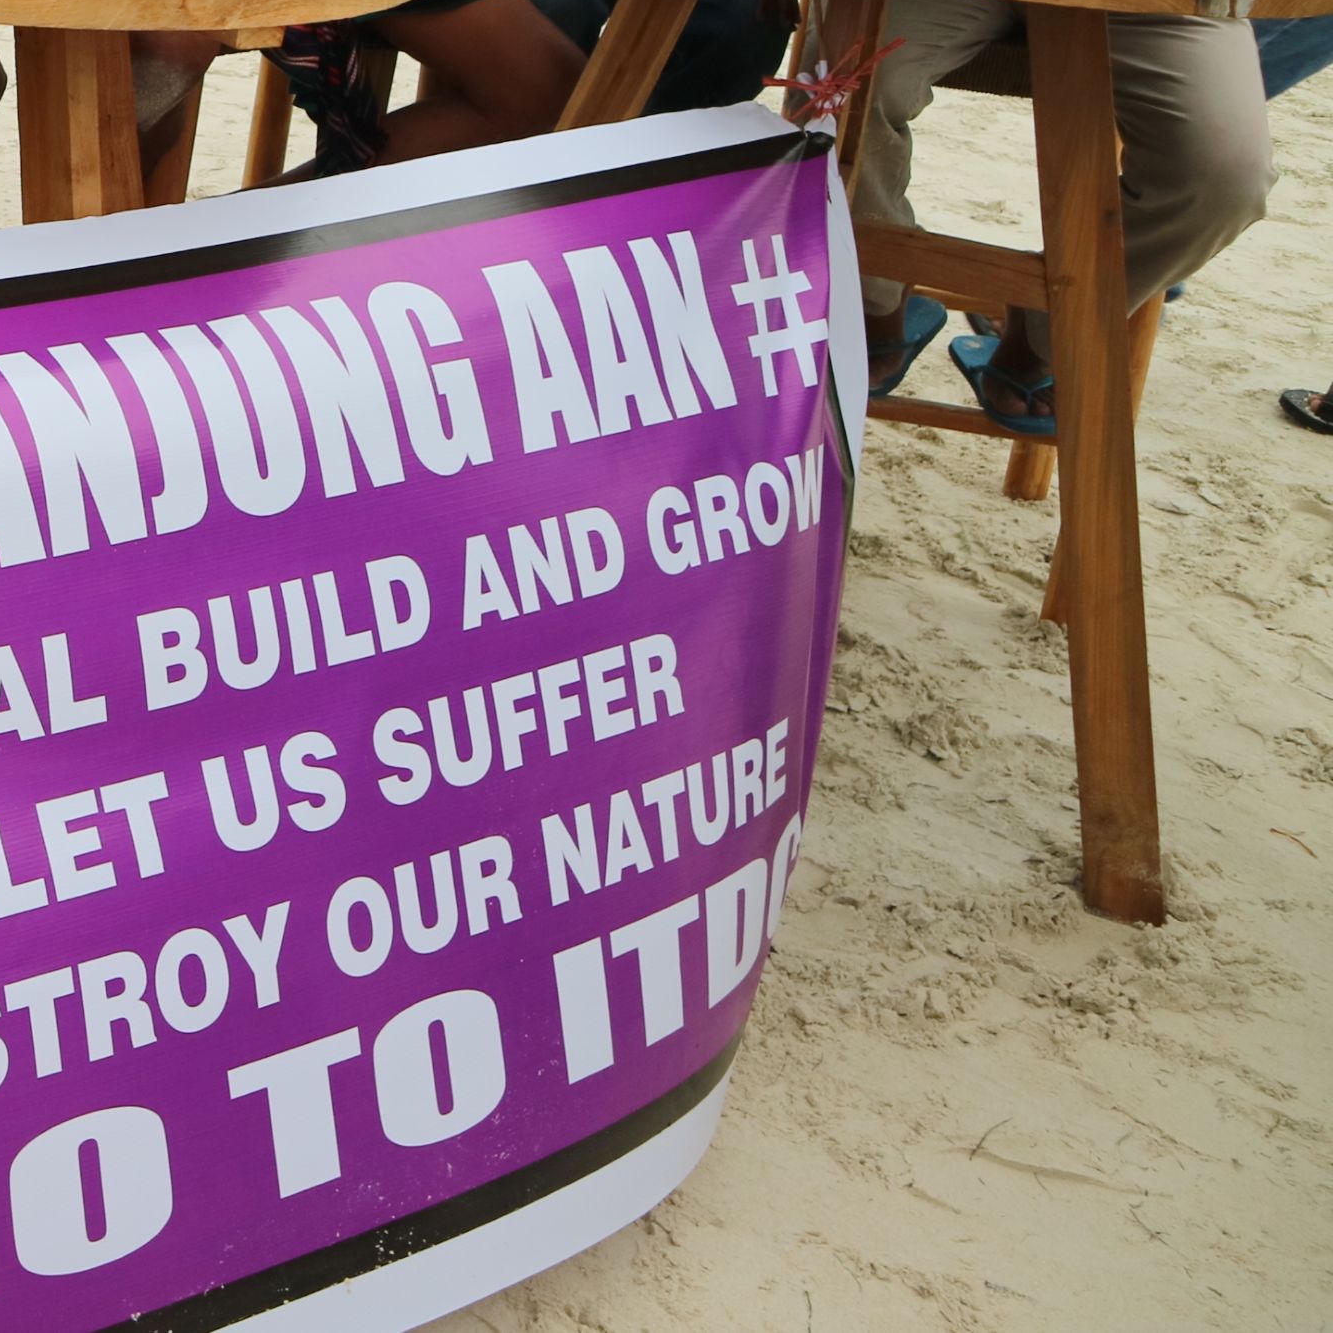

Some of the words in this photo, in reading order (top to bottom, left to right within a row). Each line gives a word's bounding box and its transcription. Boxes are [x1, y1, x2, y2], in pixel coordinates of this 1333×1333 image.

[478, 230, 738, 454] AAN
[731, 233, 828, 398] #
[137, 556, 430, 711] BUILD
[463, 507, 625, 630] AND
[647, 443, 824, 574] GROW
[201, 732, 346, 851] US
[373, 634, 685, 805] SUFFER
[327, 836, 522, 977] OUR
[541, 717, 789, 906] NATURE
[227, 990, 506, 1198] TO
